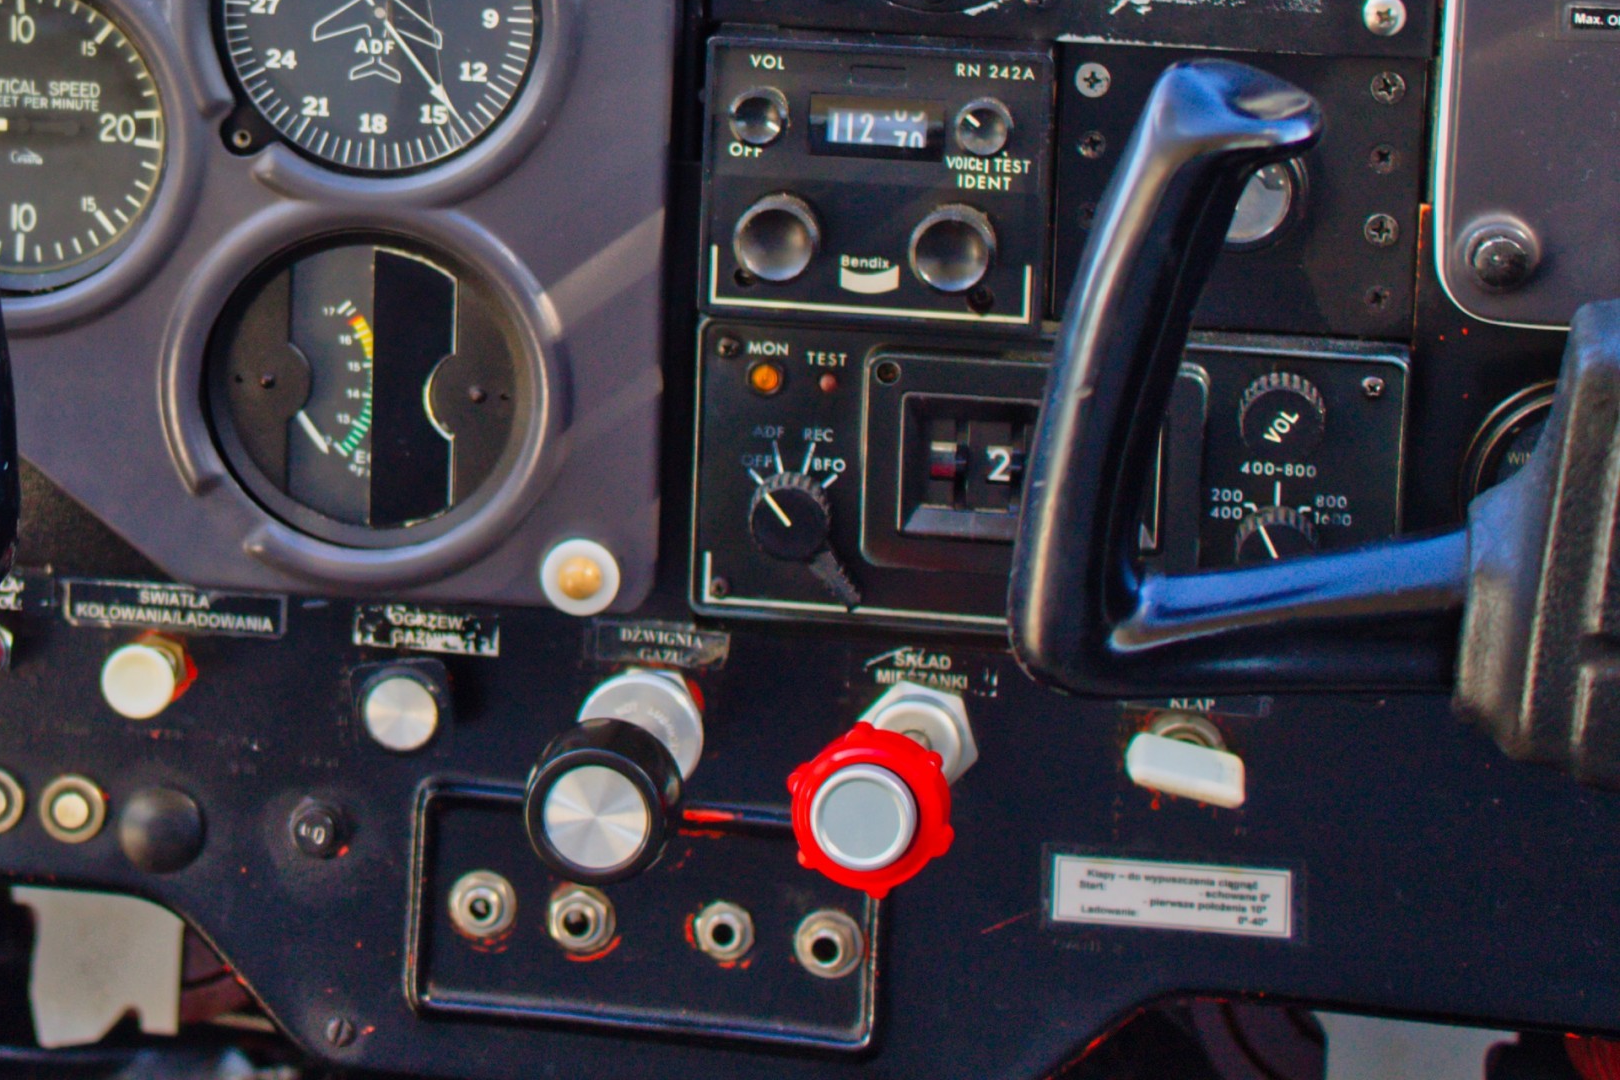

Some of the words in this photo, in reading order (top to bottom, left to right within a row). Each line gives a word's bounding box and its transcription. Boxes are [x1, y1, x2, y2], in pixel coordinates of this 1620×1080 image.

[482, 9, 499, 28] 9
[1575, 12, 1604, 25] Max.
[10, 14, 35, 44] 10
[81, 41, 96, 56] 15
[355, 39, 395, 54] ADF
[265, 49, 297, 69] 24
[750, 54, 785, 70] VOL
[460, 62, 487, 82] 12
[956, 63, 980, 77] RN
[989, 66, 1035, 80] 242A
[49, 81, 100, 98] SPEED
[24, 98, 48, 109] PER
[52, 99, 99, 112] MINUTE
[302, 96, 329, 117] 21
[420, 104, 448, 125] 15
[100, 114, 136, 142] 20
[359, 113, 387, 134] 18
[994, 156, 1031, 174] TEST
[957, 174, 1012, 191] IDENT
[81, 196, 96, 212] 15
[10, 203, 36, 232] 10
[840, 255, 890, 270] Bendix
[322, 306, 335, 316] 17
[339, 335, 352, 345] 16
[748, 341, 789, 356] MON
[807, 352, 847, 366] TEST
[348, 362, 361, 372] 15
[347, 388, 361, 398] 14
[752, 425, 784, 439] ADF
[1263, 410, 1299, 443] VOL
[804, 428, 834, 442] REC
[741, 454, 772, 468] OFF
[813, 458, 846, 473] BFO
[987, 448, 1011, 482] 2
[1240, 461, 1317, 477] 400-800
[1210, 488, 1243, 502] 200
[1315, 496, 1347, 508] 800
[1210, 506, 1242, 520] 400
